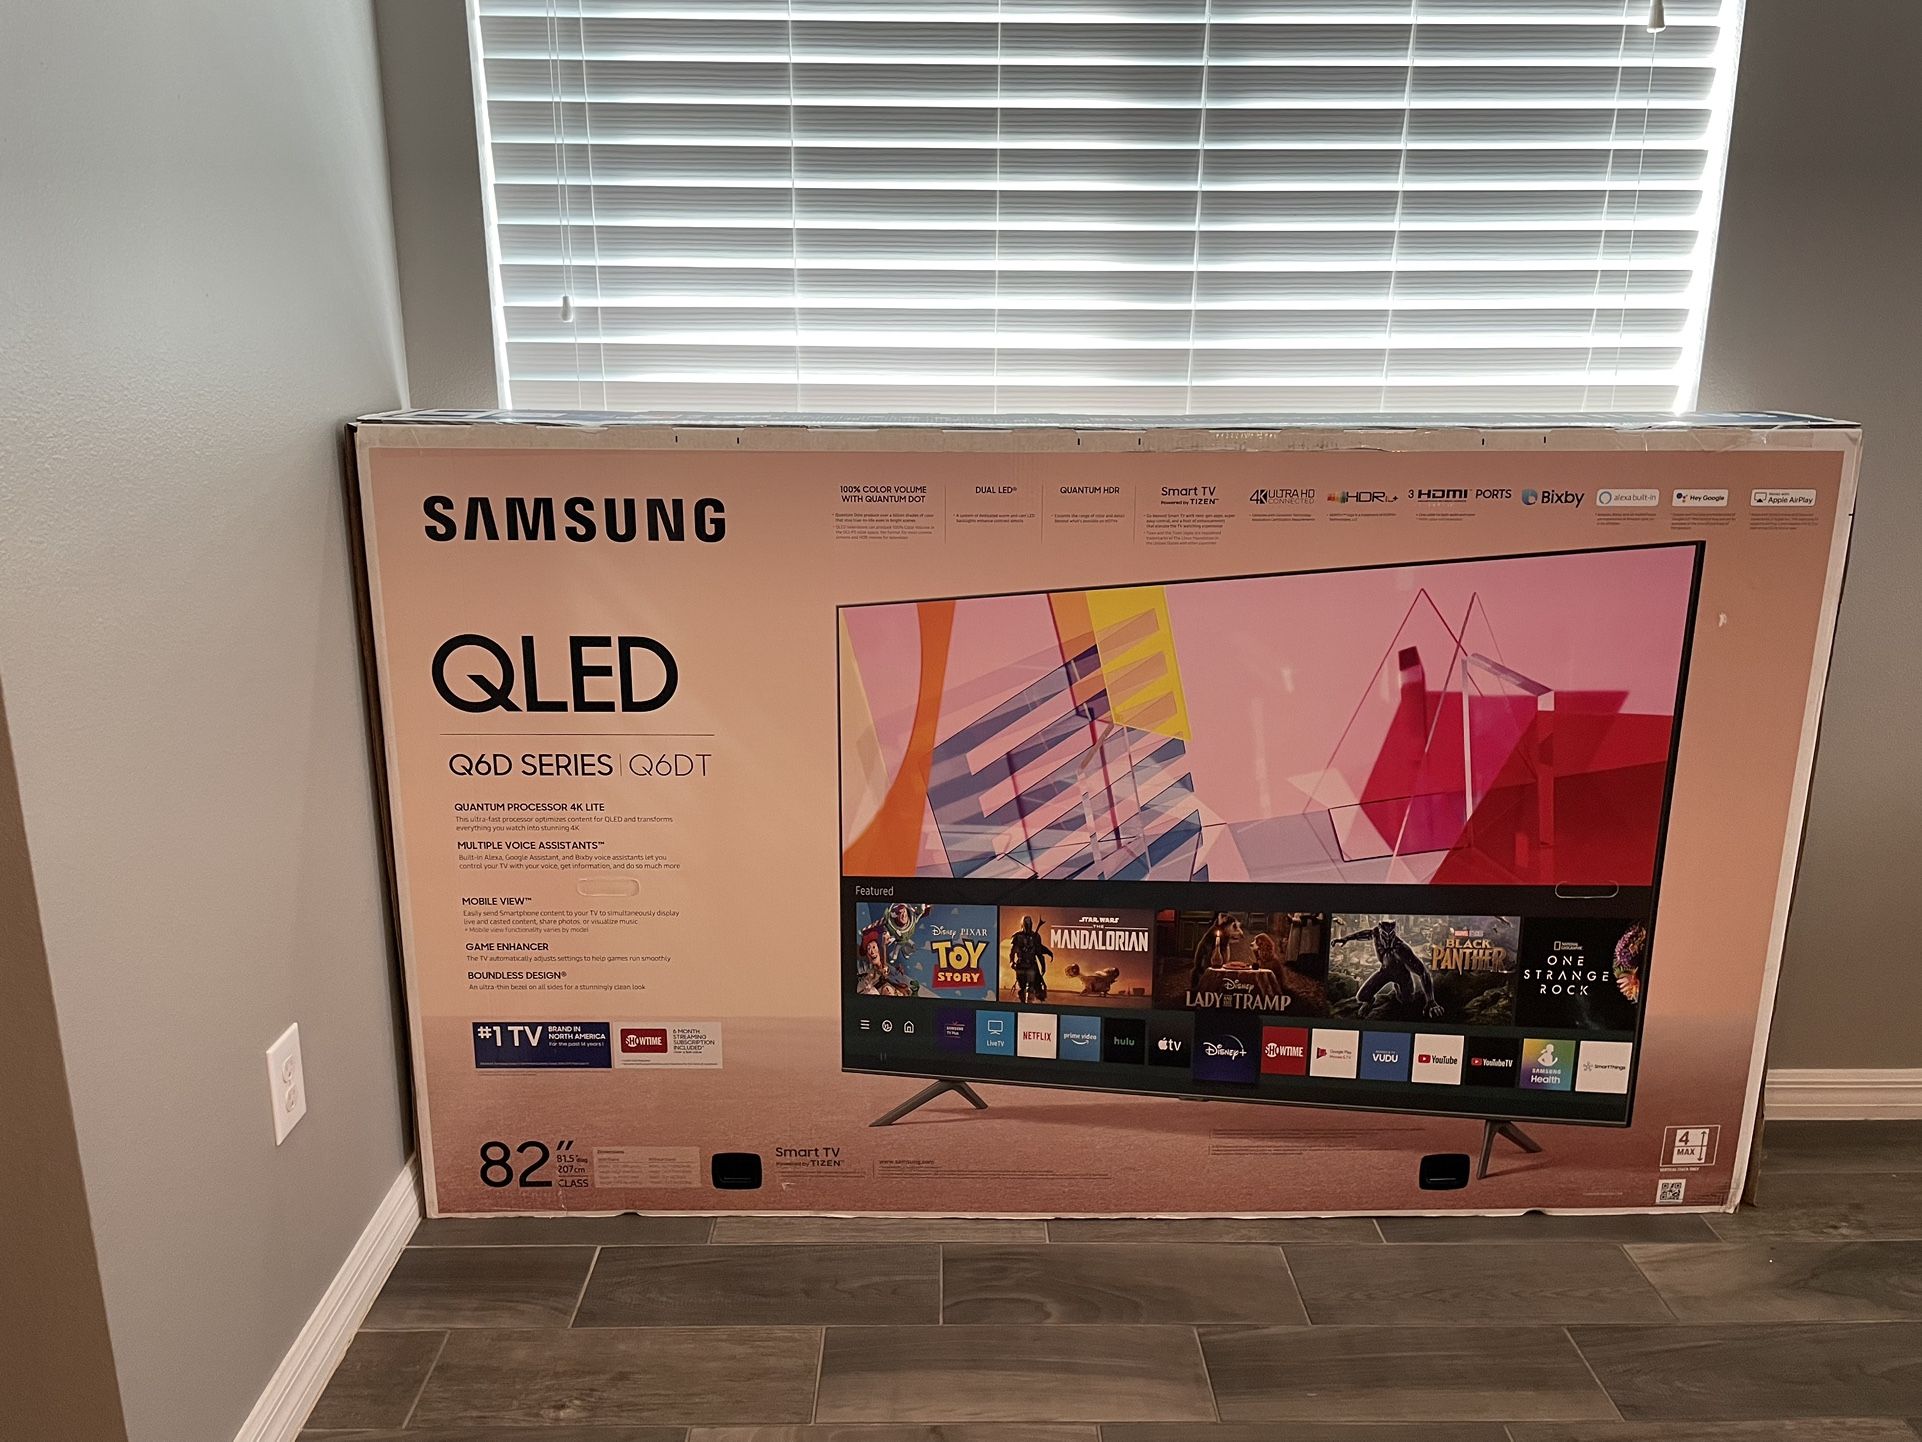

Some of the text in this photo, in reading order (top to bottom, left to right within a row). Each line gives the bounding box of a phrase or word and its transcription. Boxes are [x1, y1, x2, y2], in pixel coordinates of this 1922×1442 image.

[840, 485, 927, 494] 100% COLOR VOLUME
[975, 486, 996, 494] DUAL
[1060, 486, 1120, 494] QUANTUM HDR
[1161, 486, 1216, 497] Smart TV
[1408, 490, 1414, 499] 3
[1475, 489, 1512, 499] PORTS
[841, 495, 926, 503] WITH QUANTUM DOT
[1250, 489, 1315, 504] 4K ULTRA HD
[1541, 490, 1585, 508] Bixby
[1613, 493, 1657, 501] alexa built-in
[1703, 494, 1725, 502] Google
[1789, 496, 1813, 504] AirPlay
[423, 495, 727, 542] SAMSUNG
[431, 633, 679, 713] QLED
[449, 753, 712, 777] Q6D SERIES Q6DT
[454, 803, 605, 812] QUANTUM PROCESSOR 4K LITE
[457, 841, 503, 850] MULTIPLE
[504, 841, 536, 850] VOICE
[855, 885, 894, 896] Featured
[462, 897, 498, 906] MOBILE
[930, 924, 988, 939] Disney PIXAR
[1050, 929, 1149, 952] MANDALORIAN
[1446, 938, 1491, 949] BLACK
[466, 943, 549, 951] GAME ENHANCER
[931, 940, 988, 970] TOY
[1431, 945, 1507, 975] PANTHER
[1547, 955, 1585, 966] ONE
[468, 971, 524, 980] BOUNDLESS
[937, 972, 980, 983] STORY
[1524, 969, 1609, 982] STRANGE
[1222, 978, 1255, 993] Disney
[1540, 984, 1589, 996] ROCK
[1186, 991, 1224, 1008] LADY
[1233, 993, 1292, 1011] TRAMP
[477, 1025, 543, 1047] #1 TV
[625, 1034, 663, 1048] SHOWTIME
[1023, 1031, 1052, 1042] NETFLIX
[1114, 1036, 1135, 1046] hulu
[1168, 1039, 1182, 1052] tv
[1202, 1039, 1247, 1060] Disney+
[1265, 1042, 1304, 1058] SHOWTIME
[1372, 1053, 1399, 1063] VUDU
[1432, 1055, 1458, 1065] YouTube
[1531, 1075, 1561, 1084] Health
[1679, 1131, 1690, 1145] 4
[775, 1147, 840, 1157] Smart TV
[1677, 1148, 1695, 1156] MAX
[558, 1179, 589, 1188] CLASS
